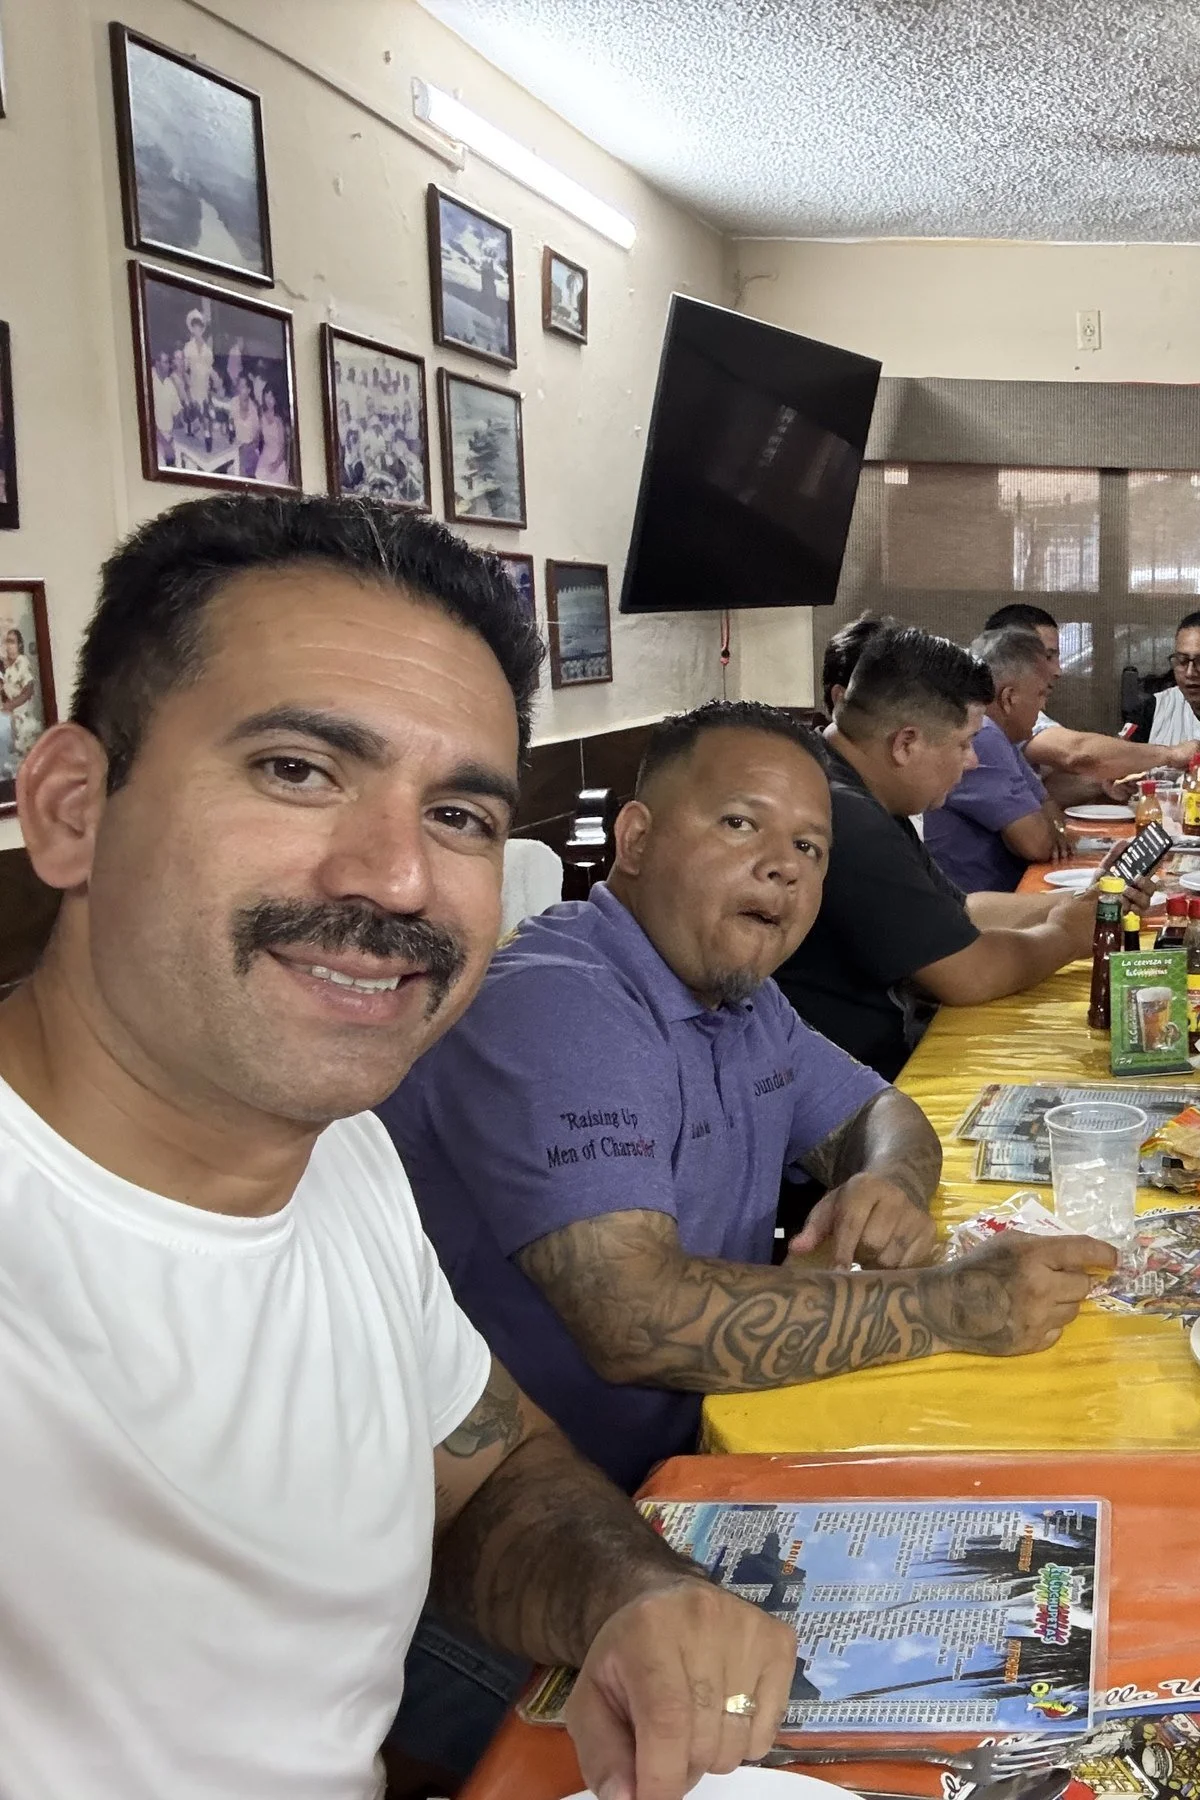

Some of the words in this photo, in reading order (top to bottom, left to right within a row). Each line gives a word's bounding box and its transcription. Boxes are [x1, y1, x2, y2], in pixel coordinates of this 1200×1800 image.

[621, 1107, 638, 1129] Up
[546, 1145, 579, 1169] Men
[582, 1139, 597, 1160] of
